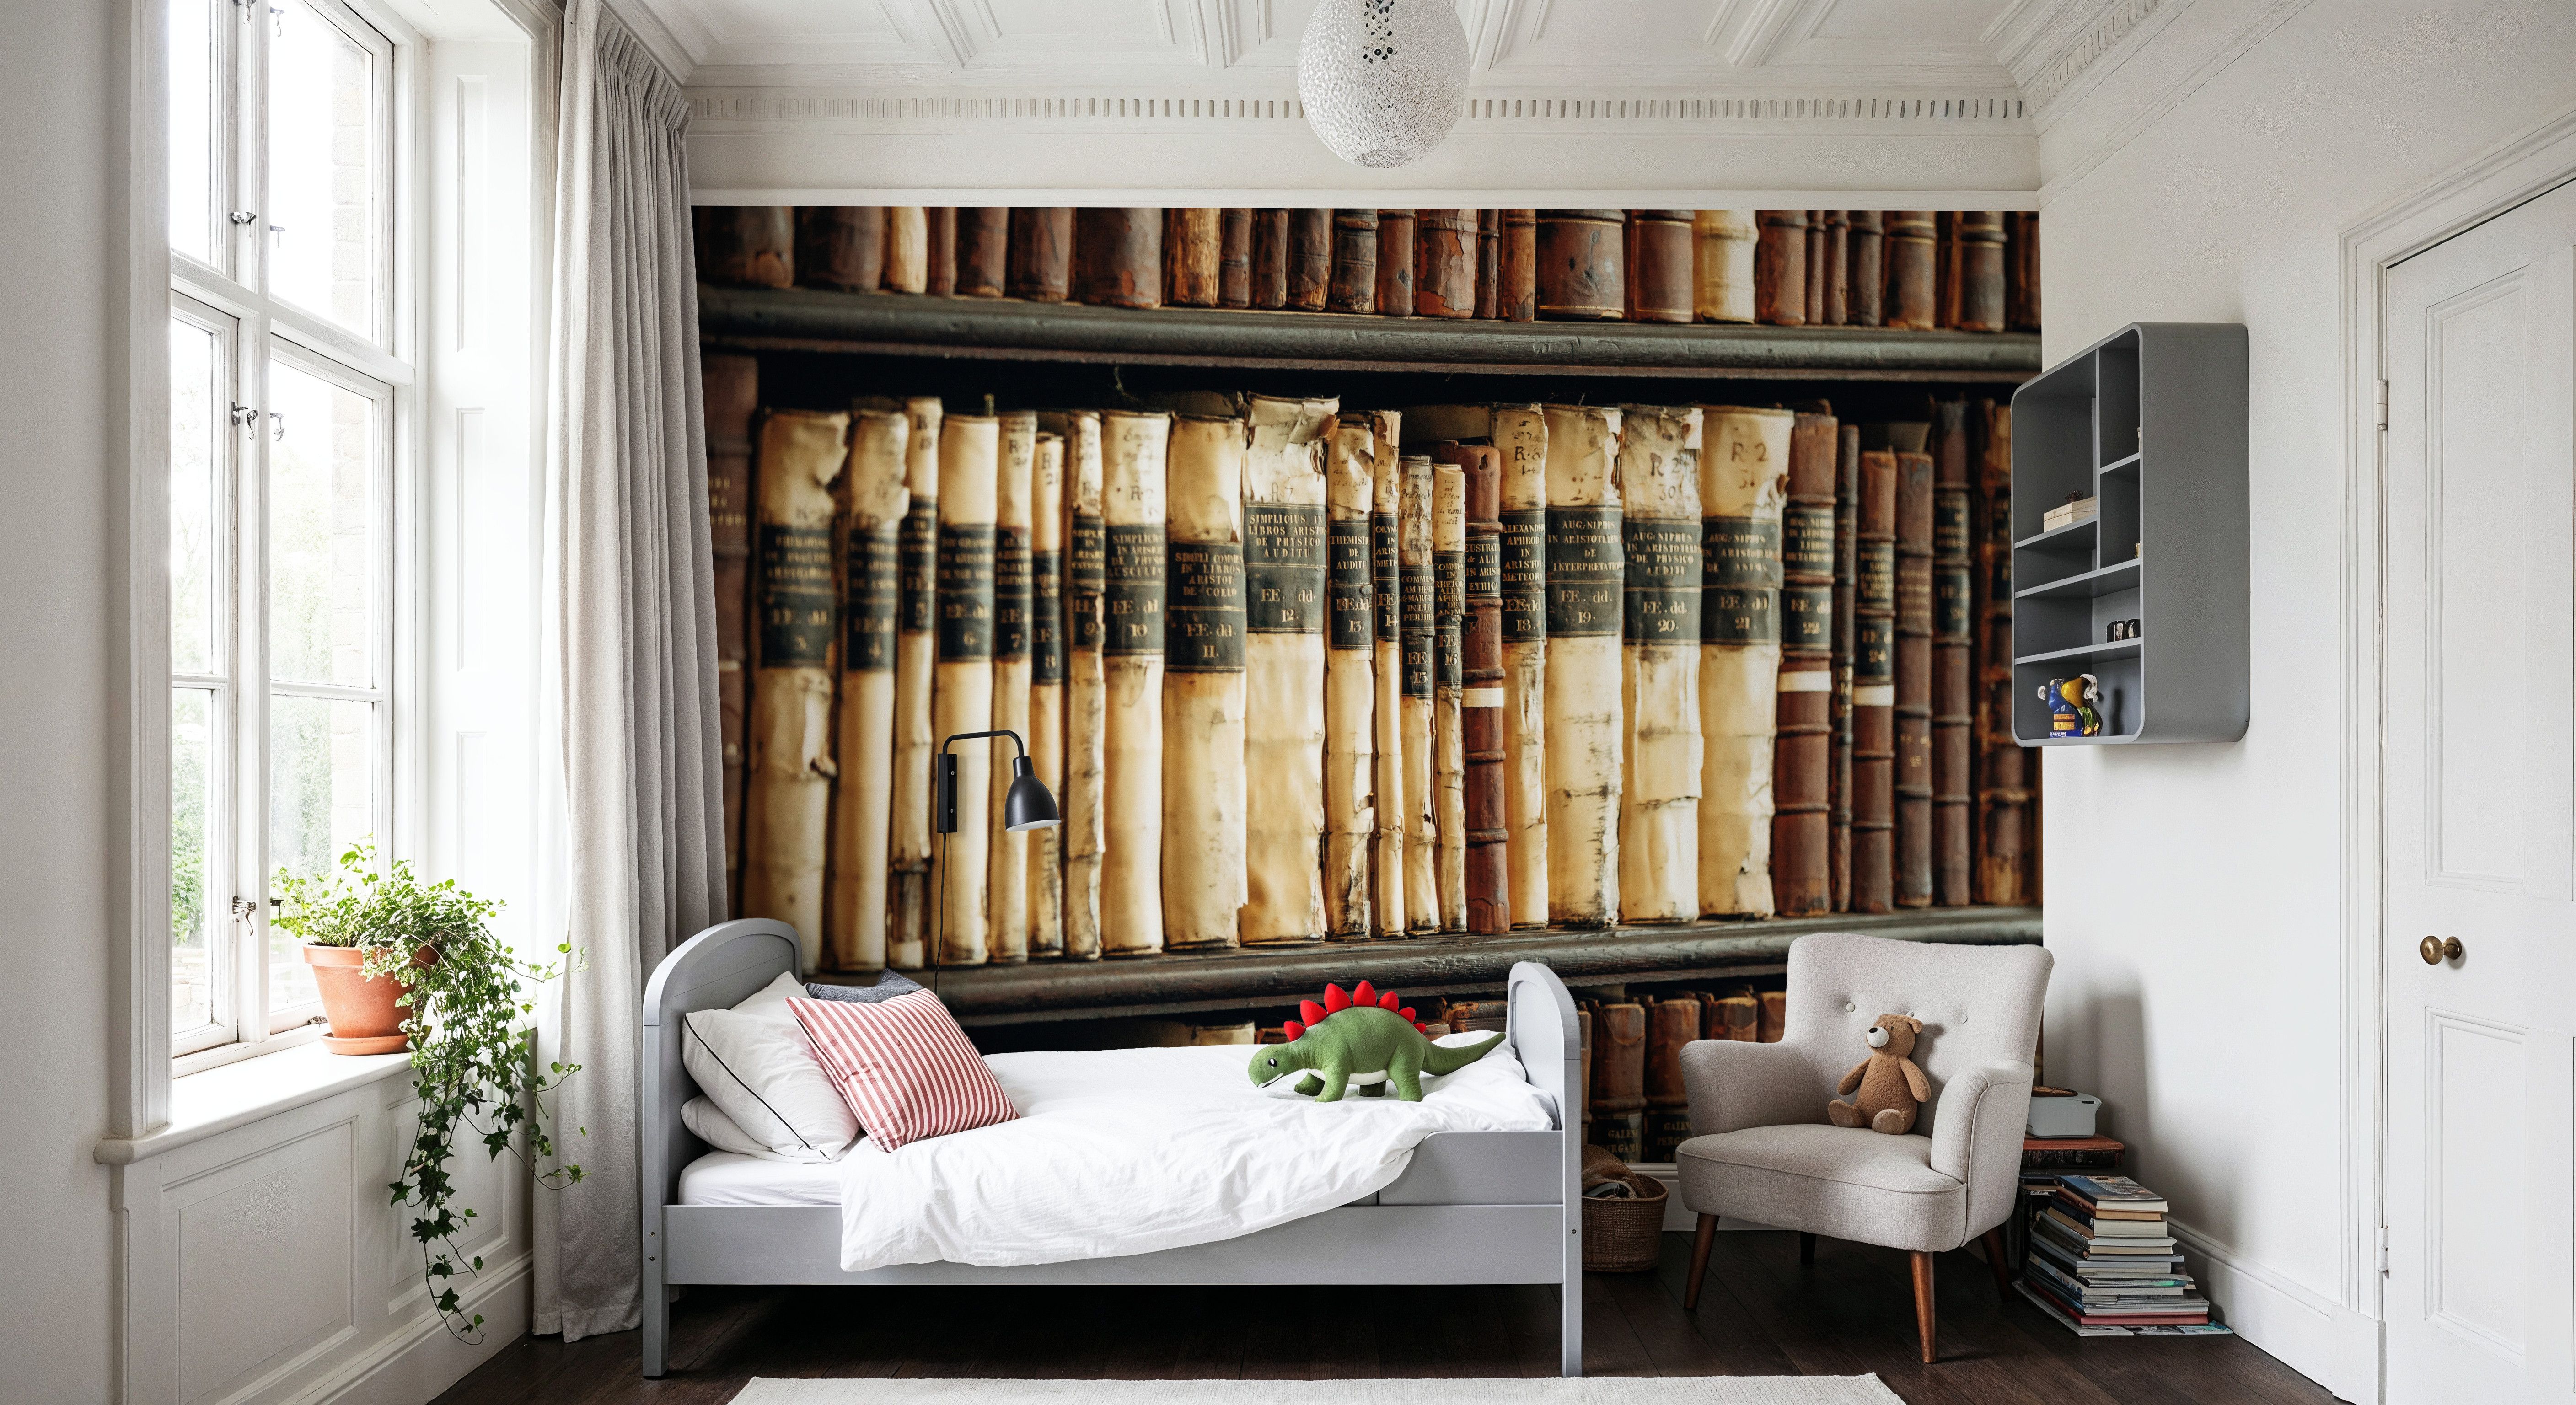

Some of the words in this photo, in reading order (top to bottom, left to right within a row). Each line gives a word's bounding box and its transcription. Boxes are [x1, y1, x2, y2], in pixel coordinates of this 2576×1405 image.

[1250, 514, 1306, 524] SIMPLICIUS
[1314, 515, 1323, 524] IN
[1248, 526, 1286, 535] LIBROS
[1256, 537, 1267, 546] DE
[1276, 537, 1320, 546] PHYSICO
[1547, 534, 1559, 543] IN
[1264, 548, 1310, 558] AUDITU
[1349, 548, 1360, 557] DE
[1520, 548, 1531, 557] IN
[1584, 549, 1596, 558] DE
[1203, 563, 1241, 574] LIBROS
[1466, 568, 1476, 576] IN
[1385, 614, 1398, 627] 14
[1128, 623, 1148, 637] 10
[1445, 653, 1458, 665] 16
